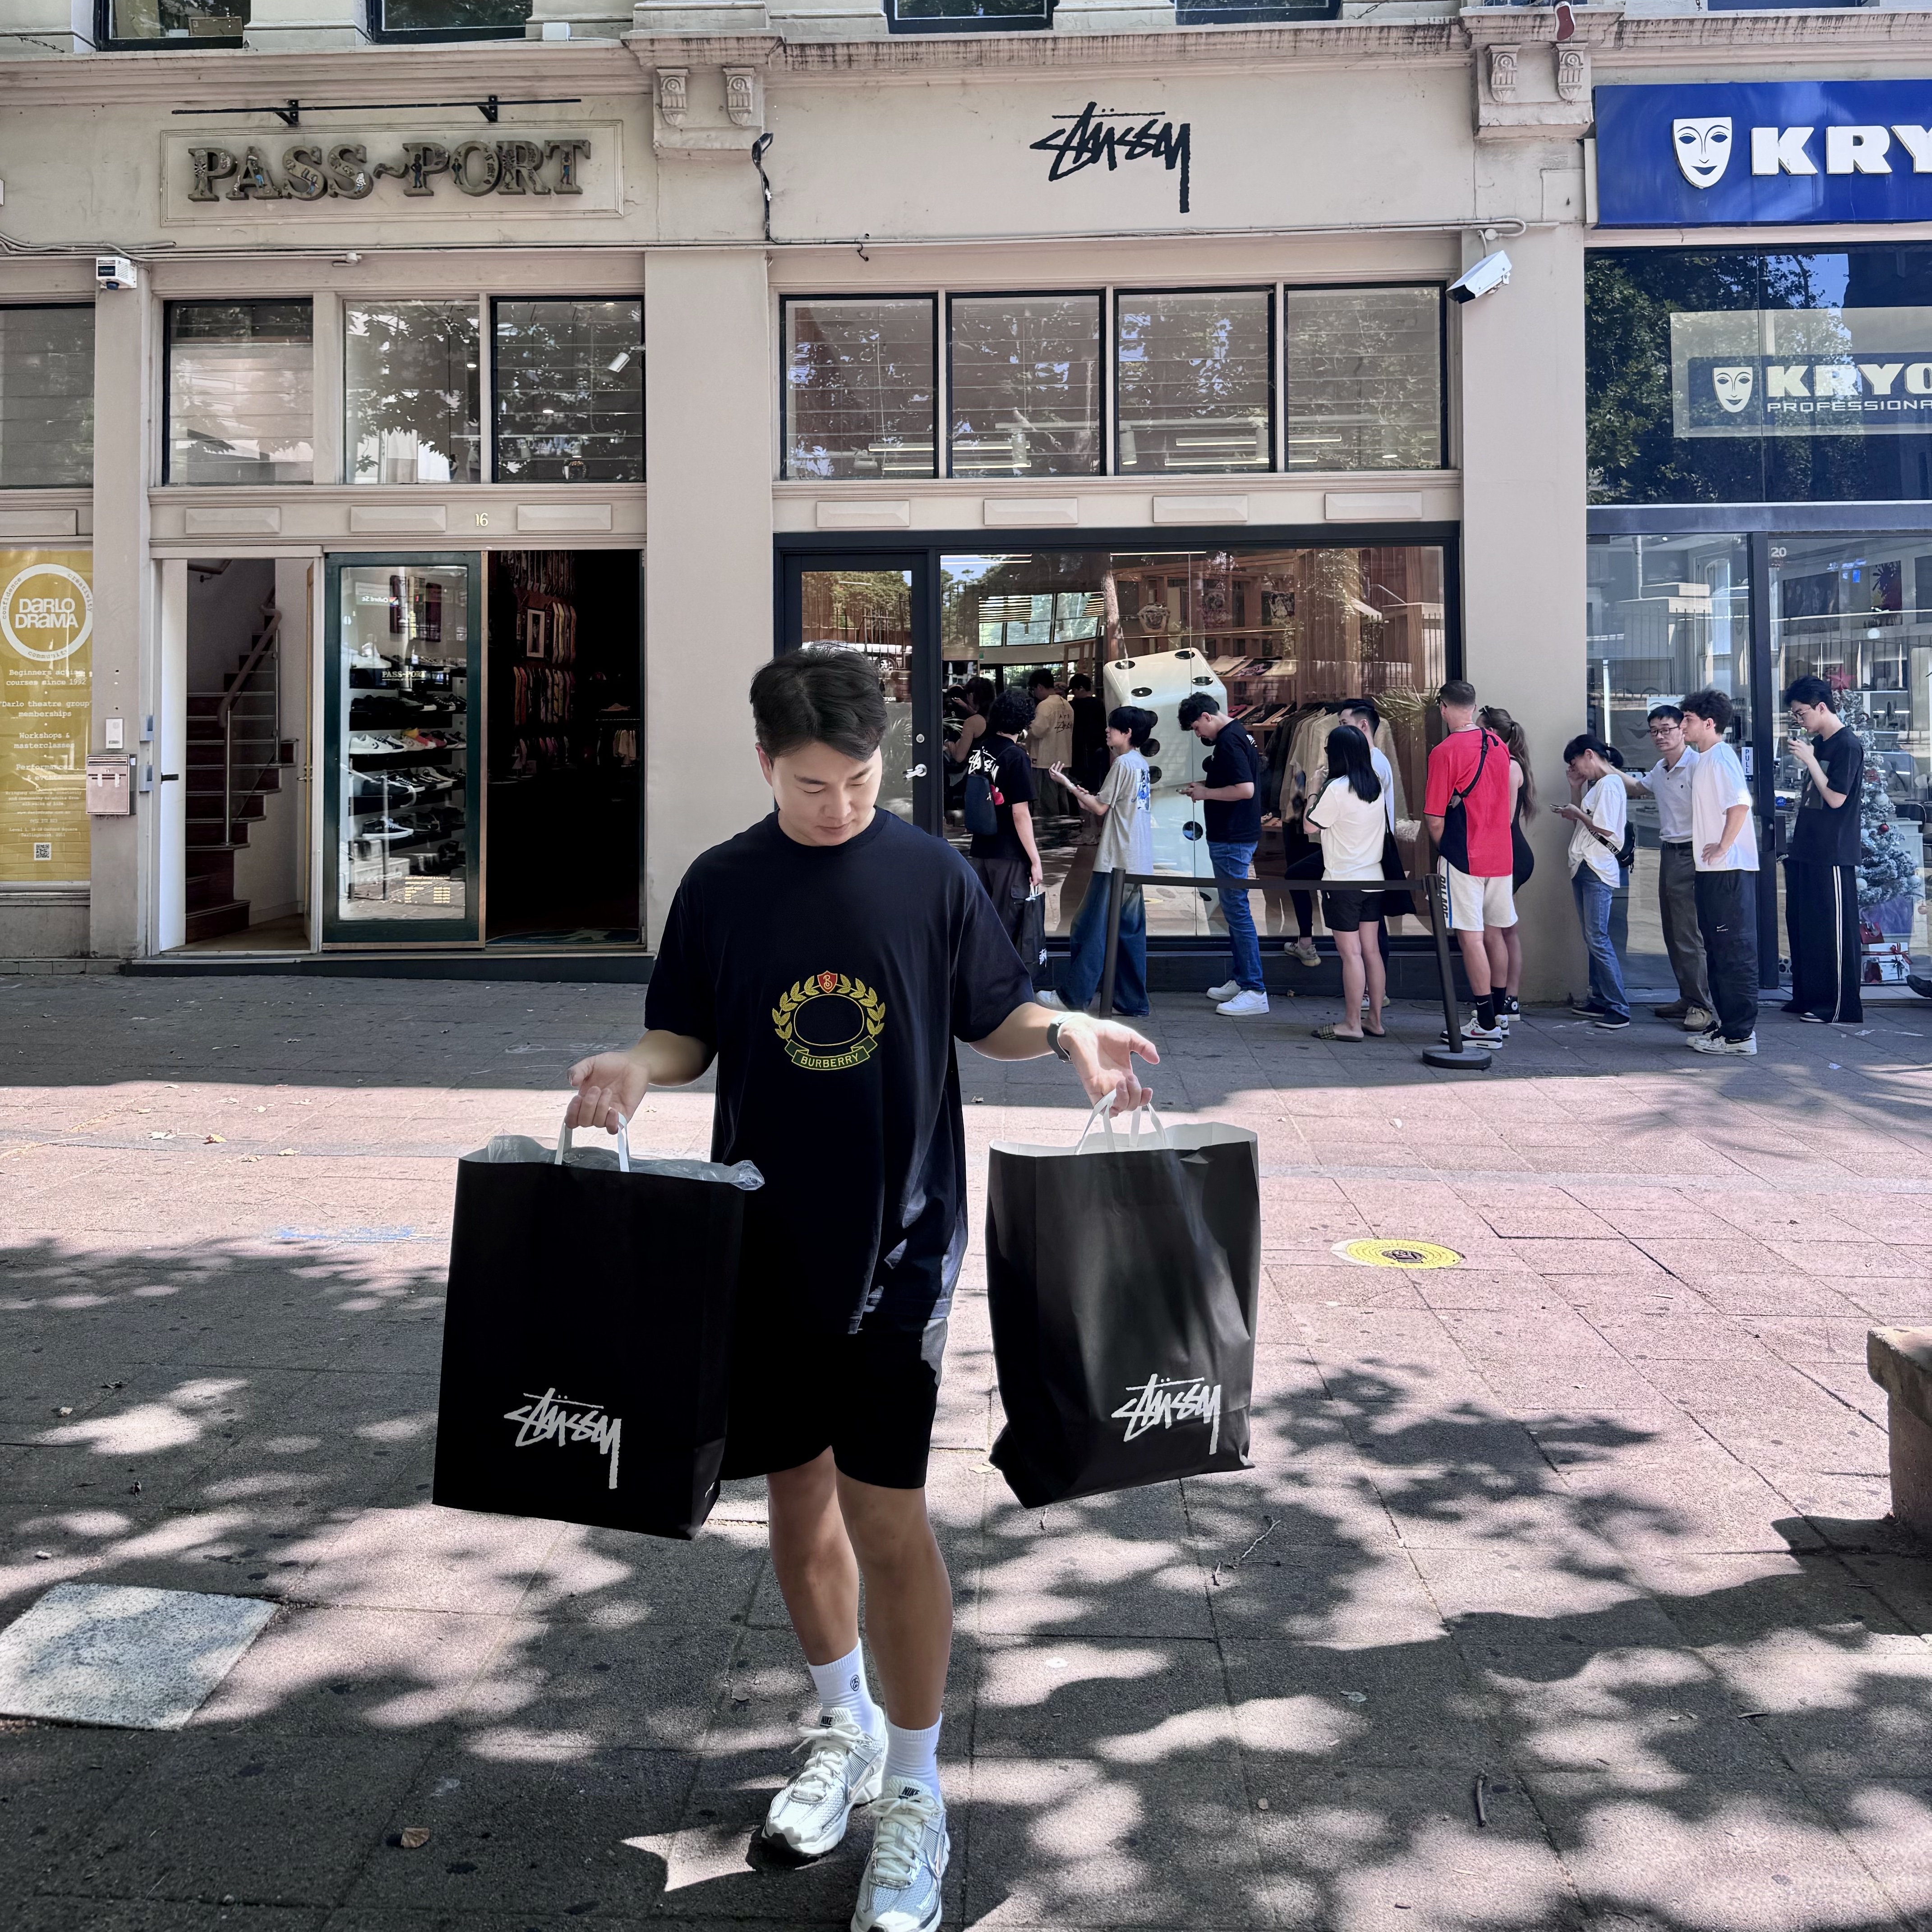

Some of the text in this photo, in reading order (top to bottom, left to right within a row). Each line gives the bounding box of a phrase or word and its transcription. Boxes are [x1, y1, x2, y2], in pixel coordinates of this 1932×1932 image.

[475, 512, 489, 527] 16
[1771, 547, 1787, 557] 20
[3, 577, 22, 619] confidence
[28, 650, 69, 659] communit
[801, 1053, 859, 1068] BURBERRY
[902, 1786, 920, 1797] NIKE
